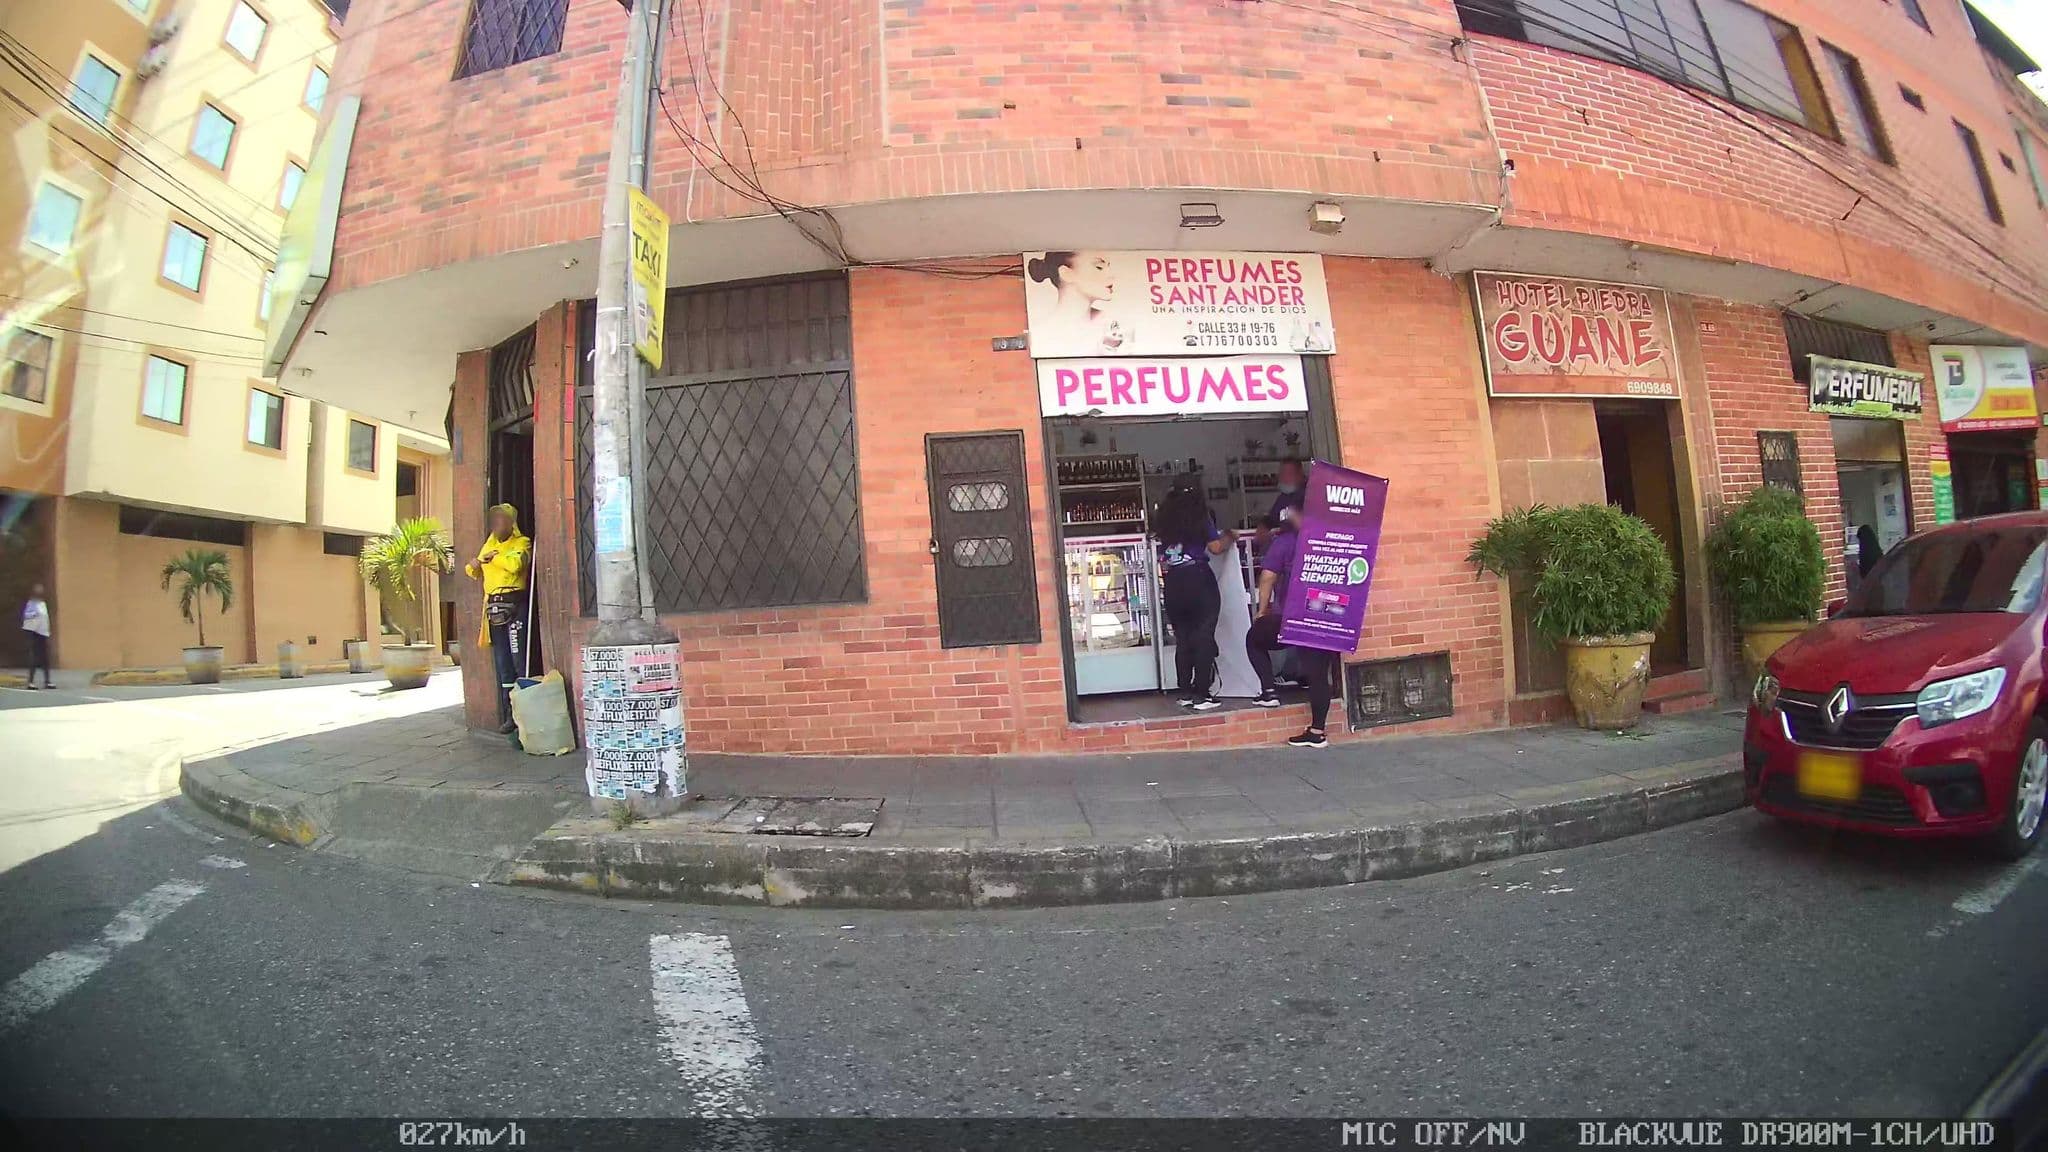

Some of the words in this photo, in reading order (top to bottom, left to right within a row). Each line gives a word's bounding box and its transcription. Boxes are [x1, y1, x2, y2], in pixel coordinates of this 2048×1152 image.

[1146, 258, 1302, 284] PERFUMES
[1150, 284, 1305, 306] SANTANDER
[1496, 279, 1572, 308] HOTEL
[1576, 287, 1652, 316] PIEDRA
[1151, 306, 1175, 314] UNA
[1261, 305, 1275, 314] DE
[1280, 306, 1307, 314] DIOS
[1198, 322, 1226, 333] CALLE
[1227, 322, 1239, 333] 33
[1250, 322, 1275, 333] 19-76
[1494, 311, 1663, 368] GUANE
[1055, 364, 1289, 407] PERFUMES
[1626, 380, 1673, 395] 6909848
[1814, 367, 1922, 407] PERFUMERIA
[1326, 484, 1365, 506] WOM
[1303, 554, 1350, 566] WHATSAPP
[1302, 562, 1346, 574] ILIMITADO
[1299, 571, 1346, 585] SIEMPRE
[623, 700, 656, 710] $7.000
[622, 751, 655, 761] $7.000
